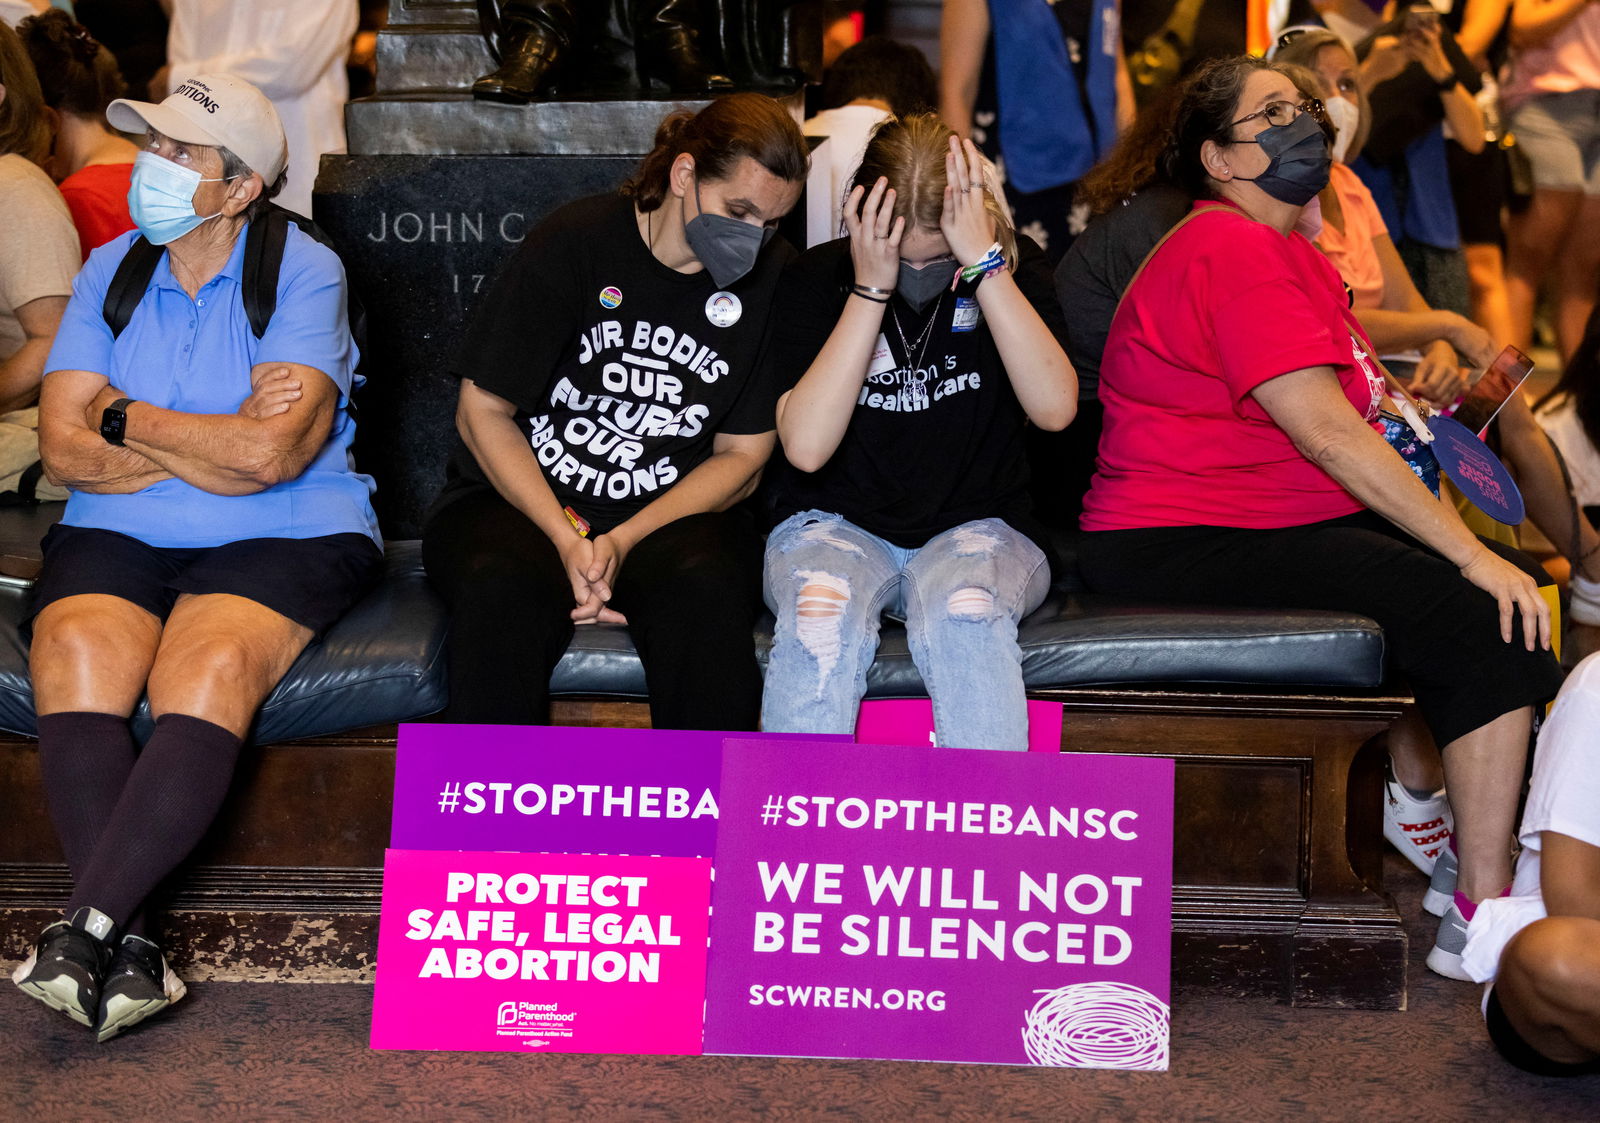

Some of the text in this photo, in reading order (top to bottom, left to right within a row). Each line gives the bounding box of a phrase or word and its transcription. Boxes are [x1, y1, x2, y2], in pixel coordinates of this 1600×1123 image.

[173, 84, 220, 114] DITIONS
[367, 212, 526, 243] JOHN C
[631, 320, 730, 384] BODIES
[865, 354, 957, 386] ortion is
[602, 362, 684, 405] OUR
[550, 376, 710, 438] FUTURES
[529, 414, 678, 500] ABORTIONS
[563, 416, 644, 471] OUR
[439, 782, 718, 819] #STOPTHEBA
[761, 796, 1138, 841] #STOPTHEBANSC
[447, 872, 648, 907] PROTECT
[758, 861, 1143, 917] WE WILL NOT
[405, 908, 681, 946] SAFE, LEGAL
[753, 911, 1133, 966] BE SILENCED
[418, 947, 660, 983] ABORTION
[518, 1011, 574, 1022] Parenthood
[519, 1001, 558, 1012] Planned
[748, 984, 946, 1012] SCWREN.ORG
